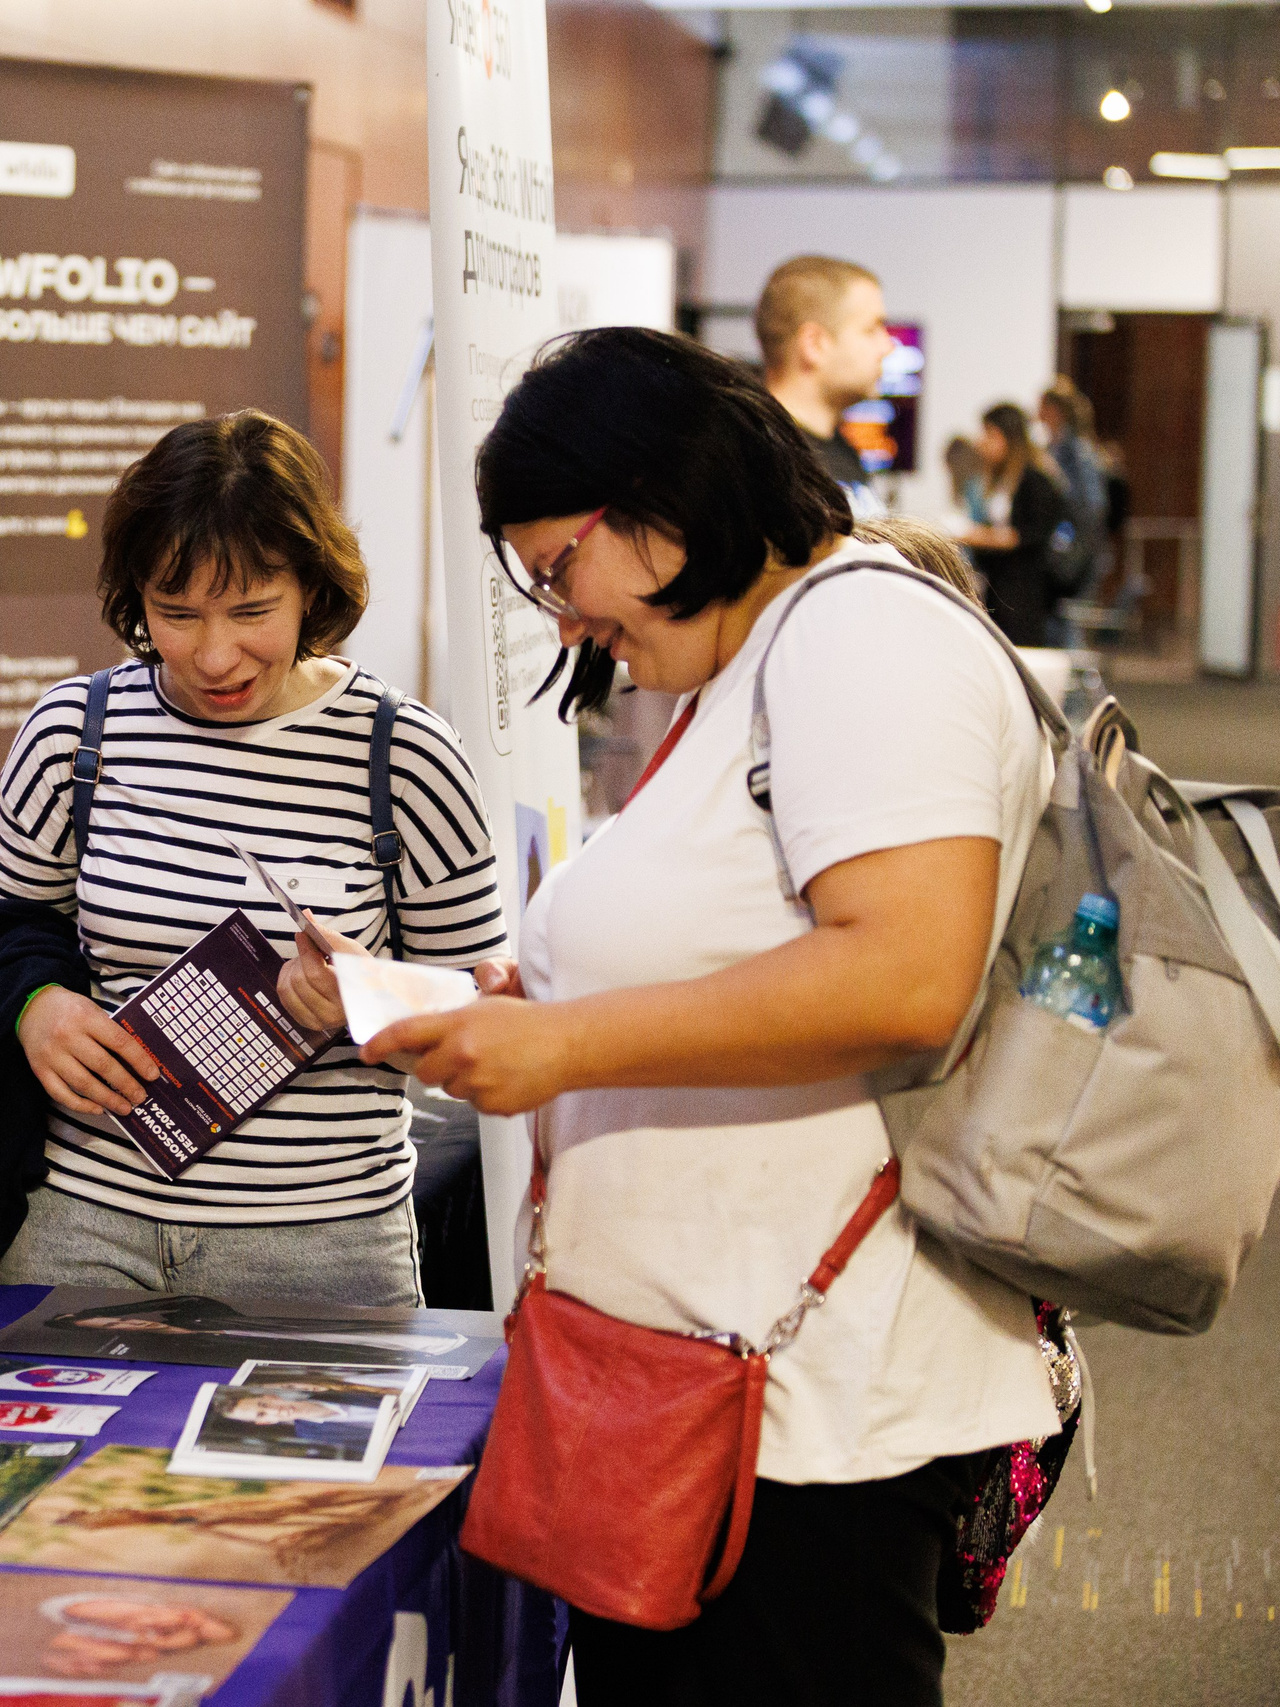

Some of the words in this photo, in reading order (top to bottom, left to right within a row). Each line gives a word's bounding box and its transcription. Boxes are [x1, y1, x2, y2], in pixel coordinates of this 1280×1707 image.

[113, 312, 178, 347] ЧЕМ
[177, 308, 258, 350] САЙТ
[120, 1019, 135, 1034] 2024
[150, 1102, 176, 1130] 2024
[132, 1105, 188, 1163] MOSCOW.P
[172, 1128, 199, 1155] FEST
